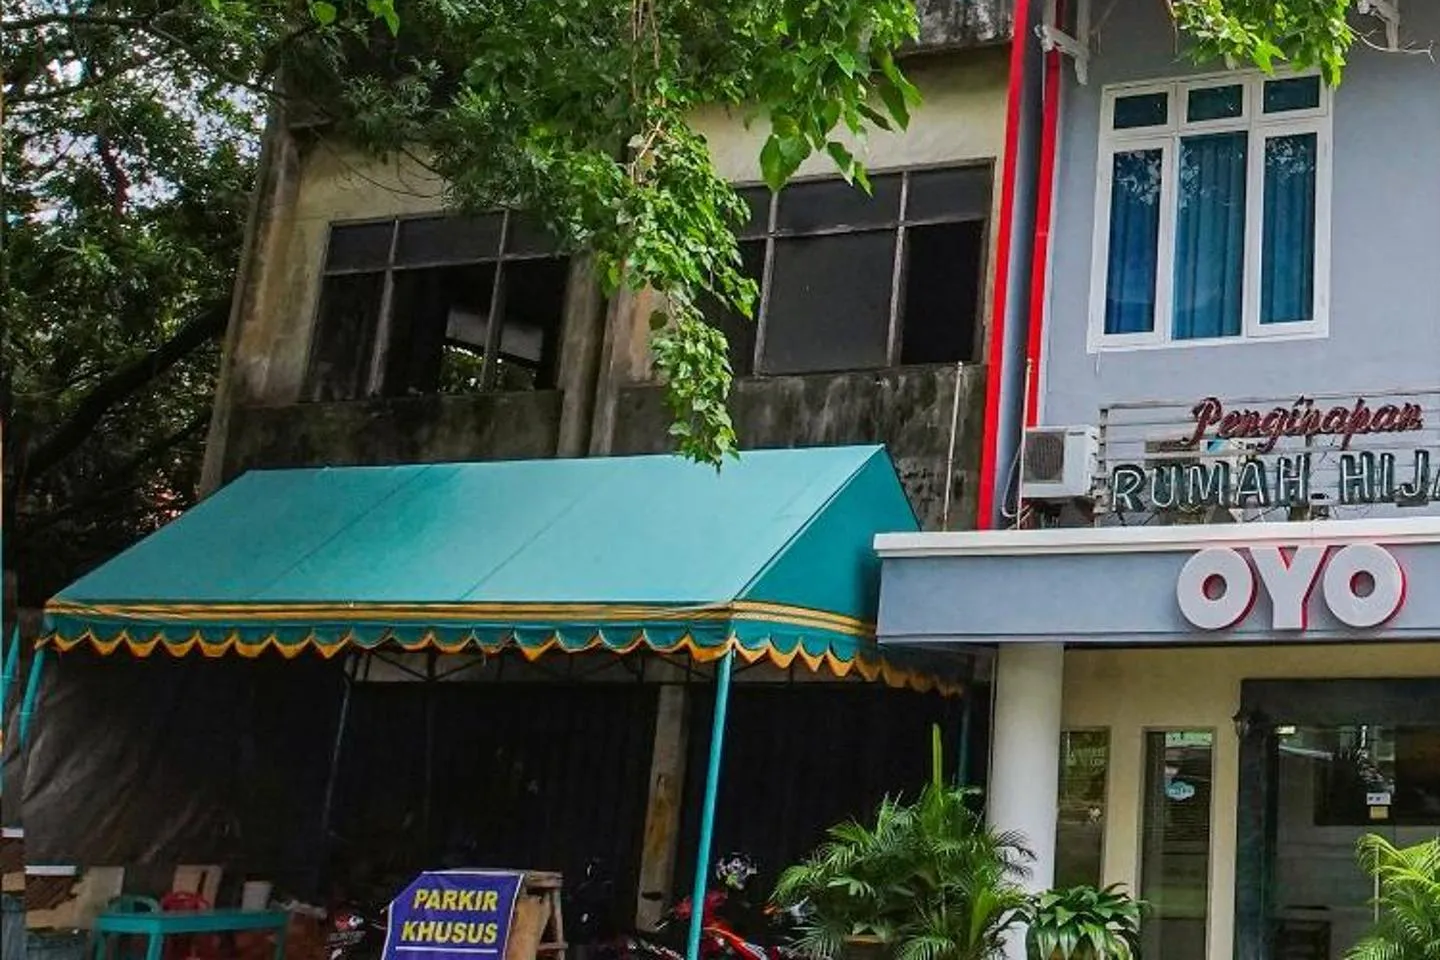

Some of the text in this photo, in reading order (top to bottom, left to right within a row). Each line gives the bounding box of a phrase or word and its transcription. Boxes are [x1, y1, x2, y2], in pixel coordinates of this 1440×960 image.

[1184, 395, 1424, 453] Penginapan
[1111, 452, 1311, 513] RUMAH
[1176, 543, 1407, 632] OYO
[413, 889, 498, 912] PARKIR
[401, 920, 498, 944] KHUSUS
